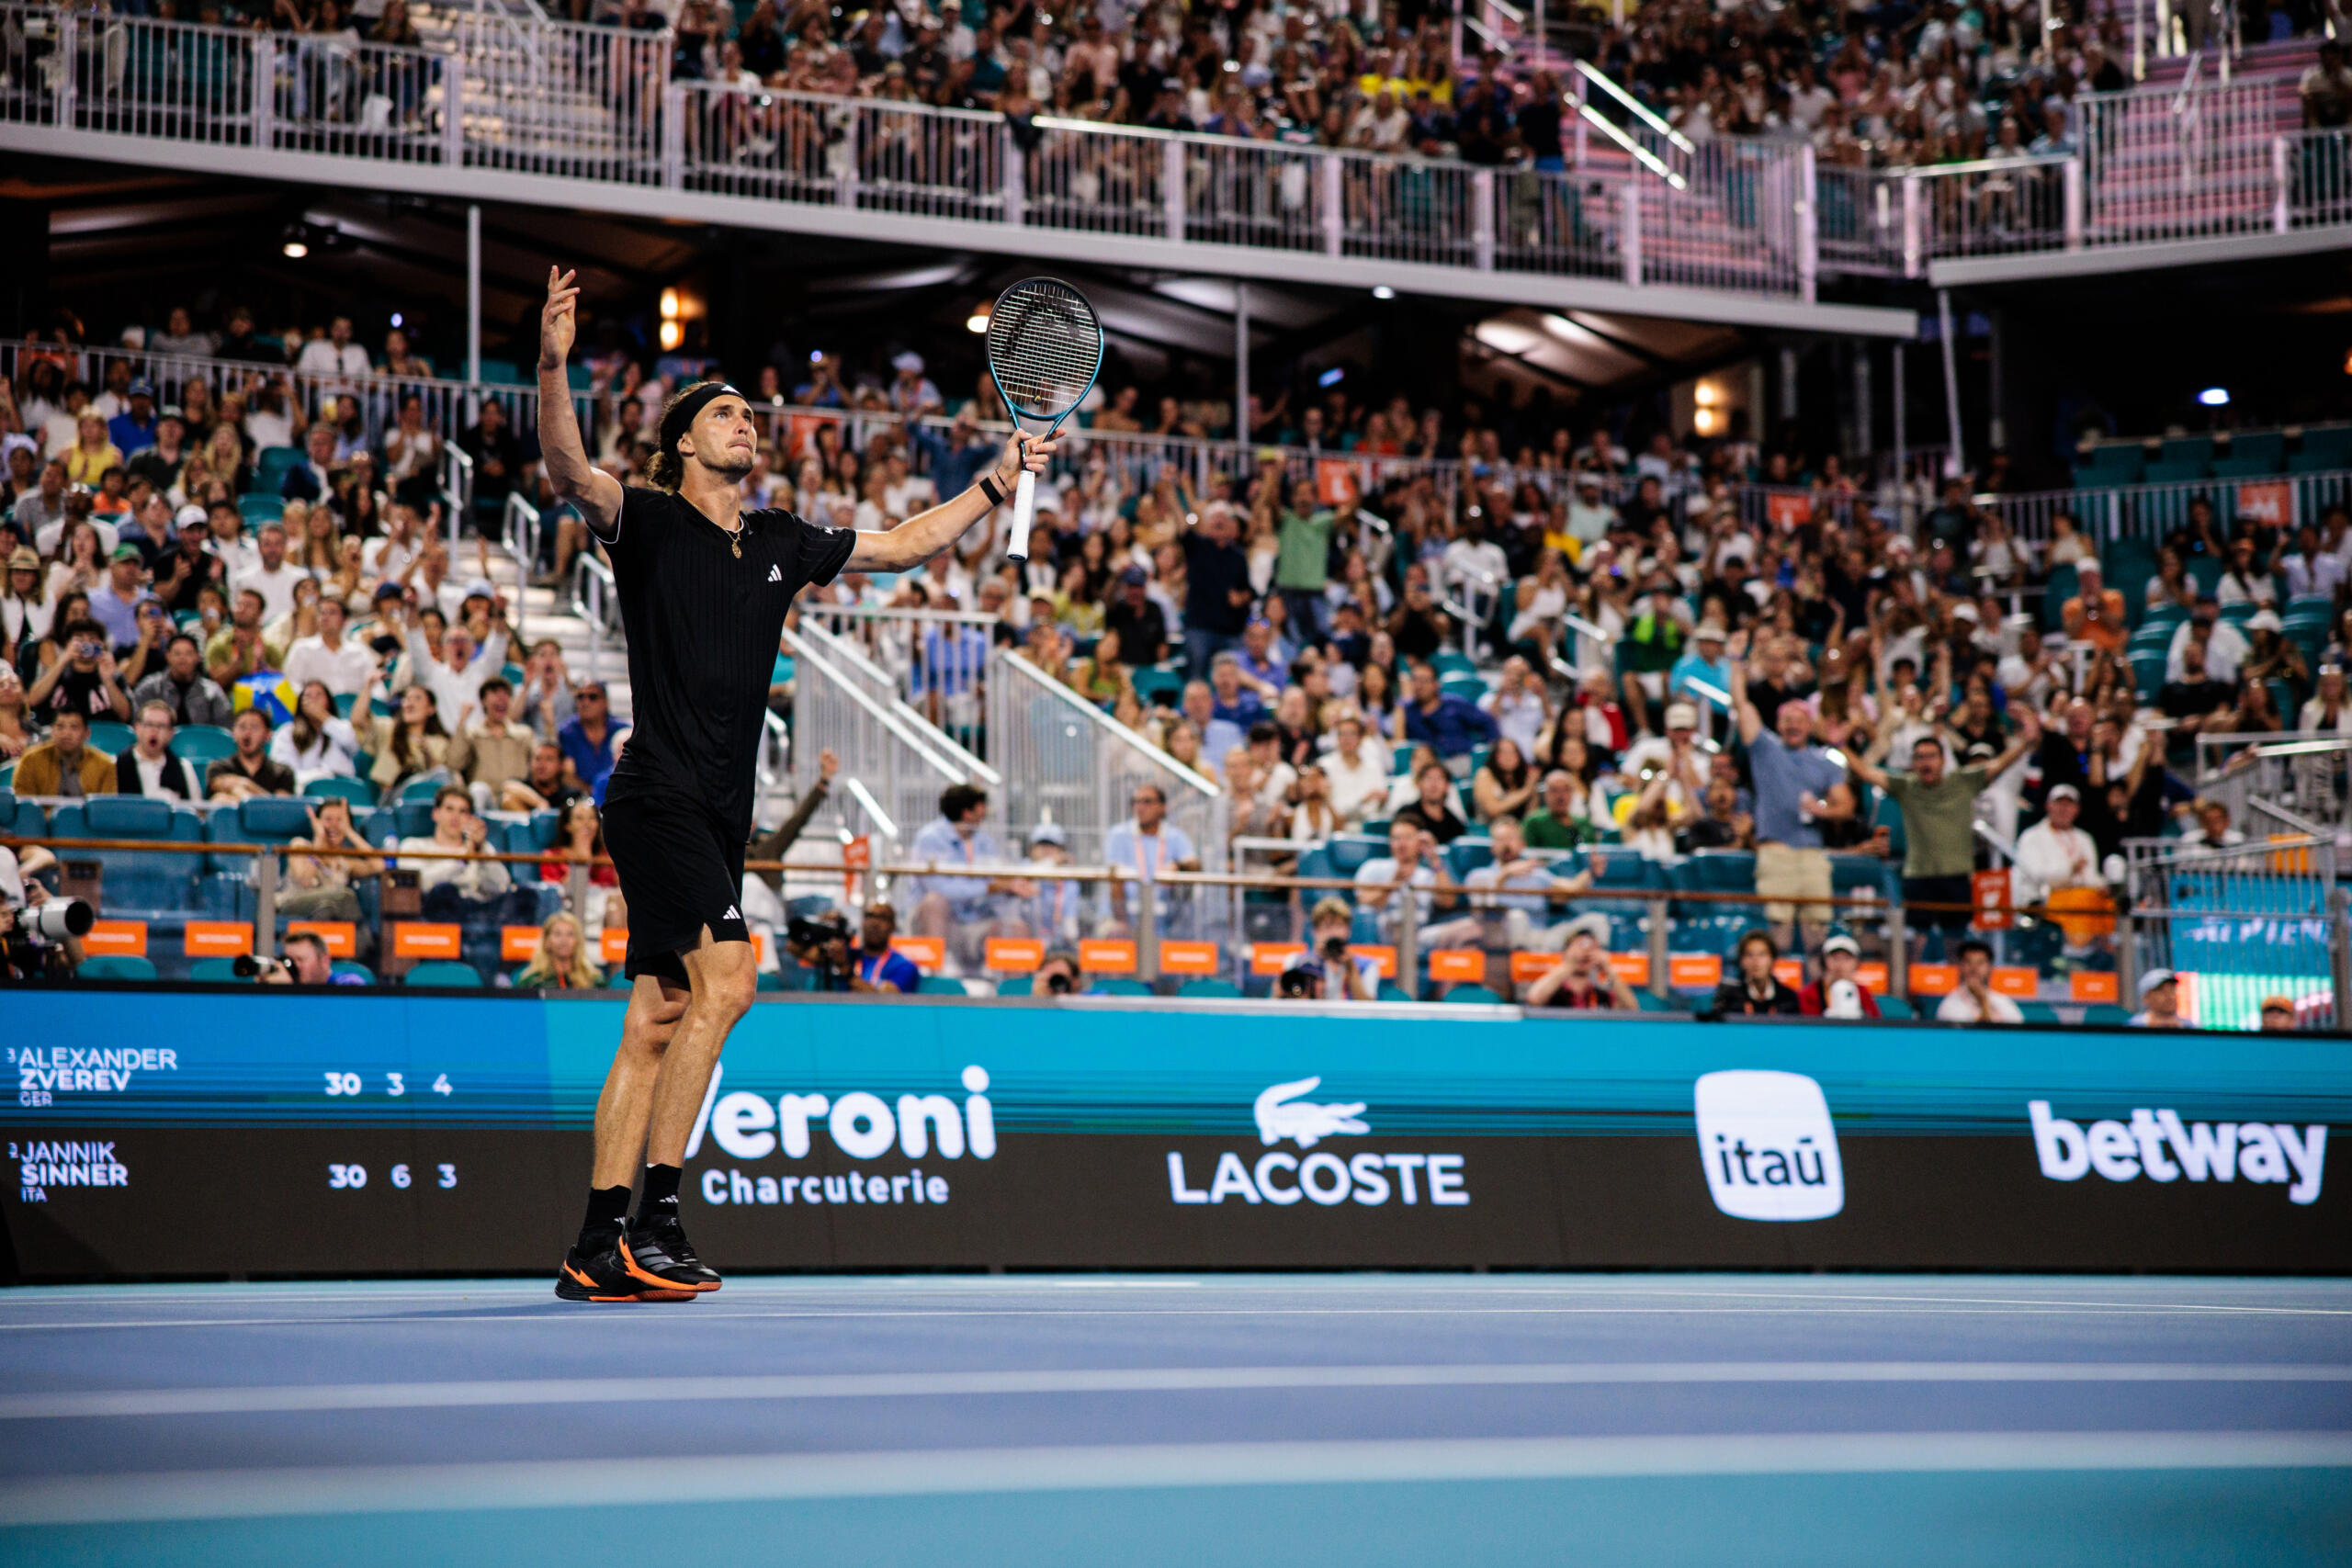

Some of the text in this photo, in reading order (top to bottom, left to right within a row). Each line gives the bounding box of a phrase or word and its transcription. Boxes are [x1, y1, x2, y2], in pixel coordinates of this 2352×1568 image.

[7, 1046, 177, 1071] 3 ALEXANDER
[19, 1068, 131, 1092] ZVEREV
[323, 1072, 453, 1097] 30 3 4
[7, 1140, 117, 1164] 2 JANNIK
[2028, 1099, 2329, 1205] betway
[20, 1162, 129, 1186] SINNER
[328, 1163, 458, 1189] 30 6 3
[701, 1168, 949, 1205] Charcuterie
[1167, 1151, 1471, 1206] LACOSTE
[20, 1186, 48, 1202] ITA
